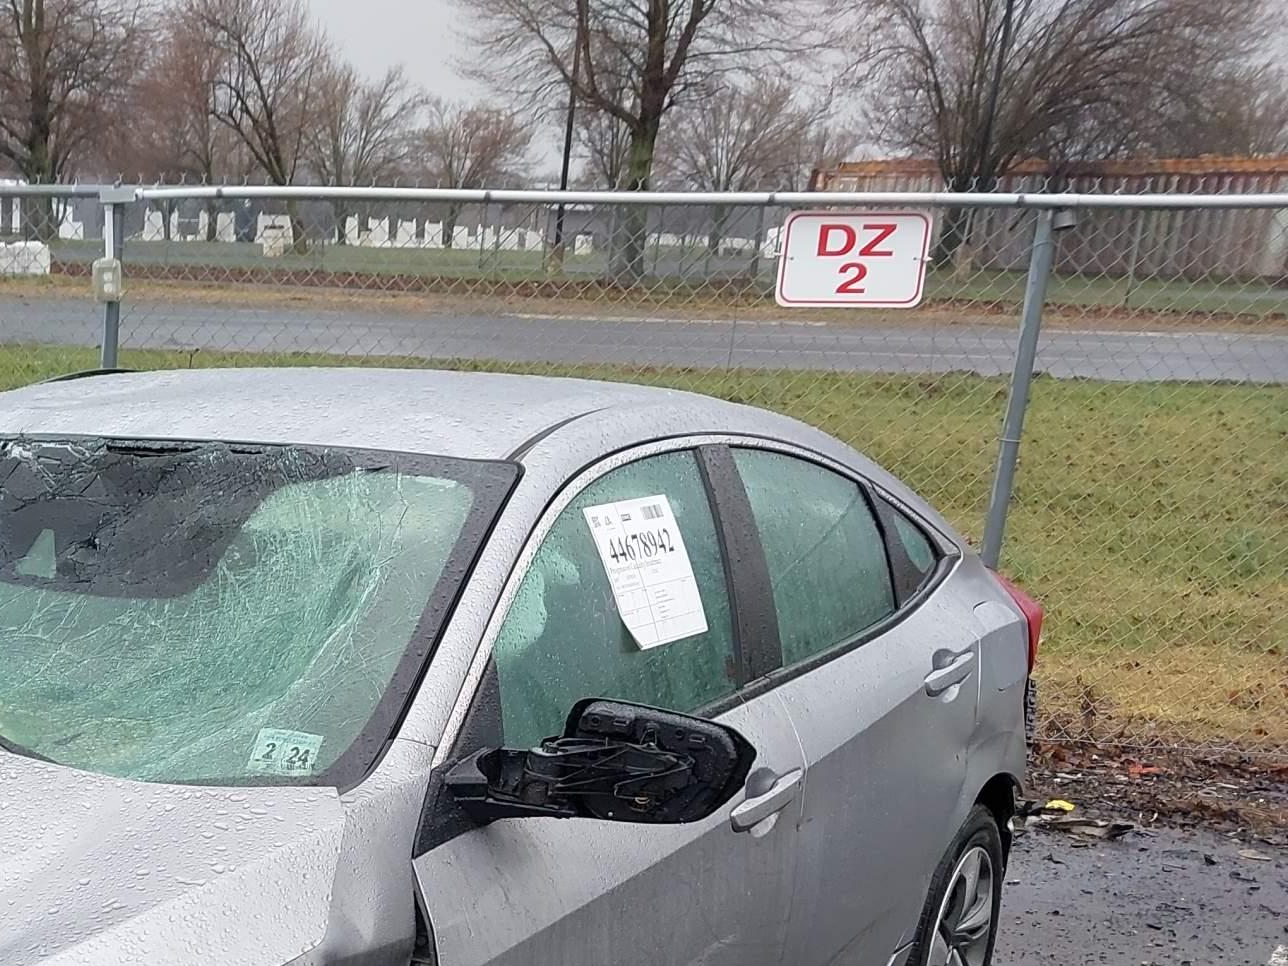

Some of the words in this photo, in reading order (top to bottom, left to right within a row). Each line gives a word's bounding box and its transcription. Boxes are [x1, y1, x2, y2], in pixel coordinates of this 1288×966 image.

[816, 223, 898, 257] DZ
[835, 262, 868, 294] 2
[609, 528, 674, 564] 44678942
[262, 742, 277, 760] 2
[286, 747, 310, 766] 24
